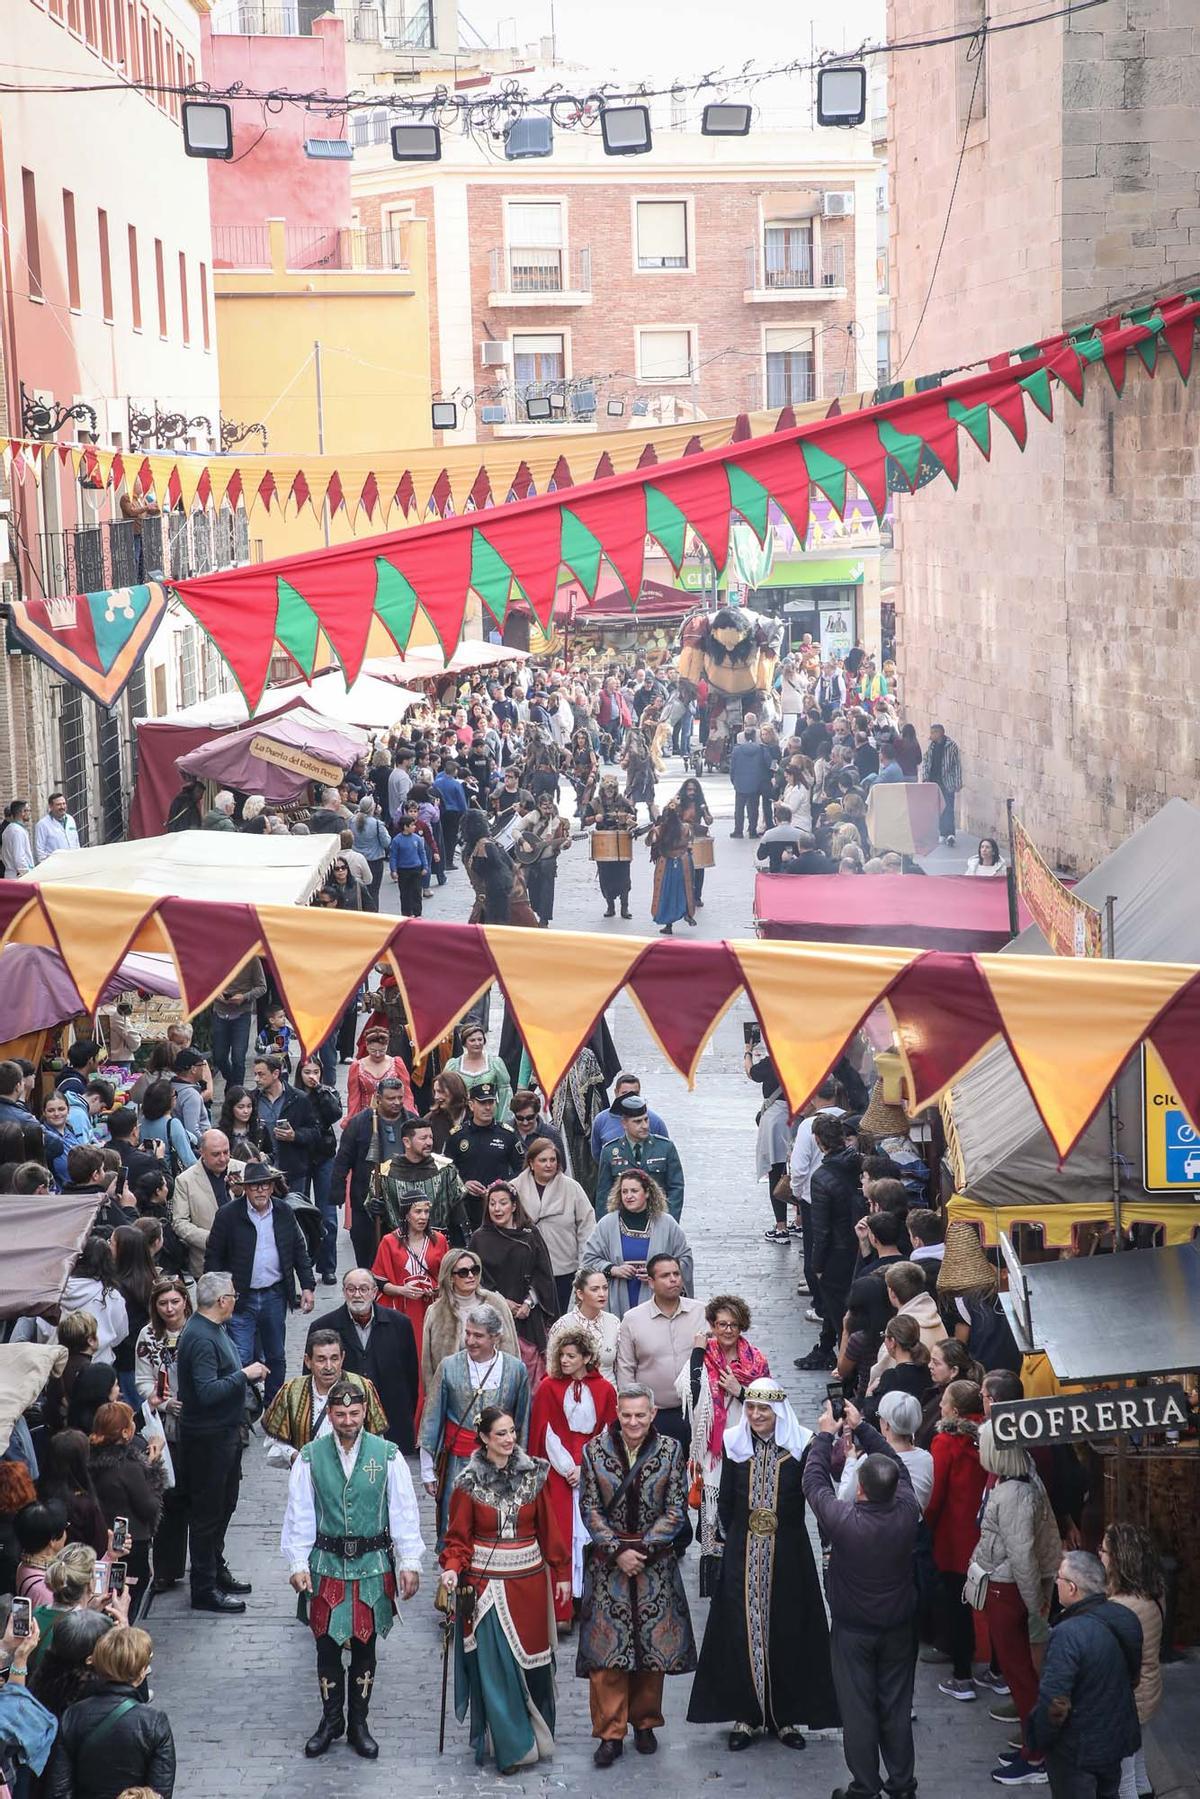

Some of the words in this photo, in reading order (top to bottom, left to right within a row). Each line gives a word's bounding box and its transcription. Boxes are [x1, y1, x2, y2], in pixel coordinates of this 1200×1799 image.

[255, 743, 265, 752] La
[265, 746, 288, 761] Puerta
[288, 756, 299, 766] del
[994, 1395, 1187, 1441] GOFRERIA
